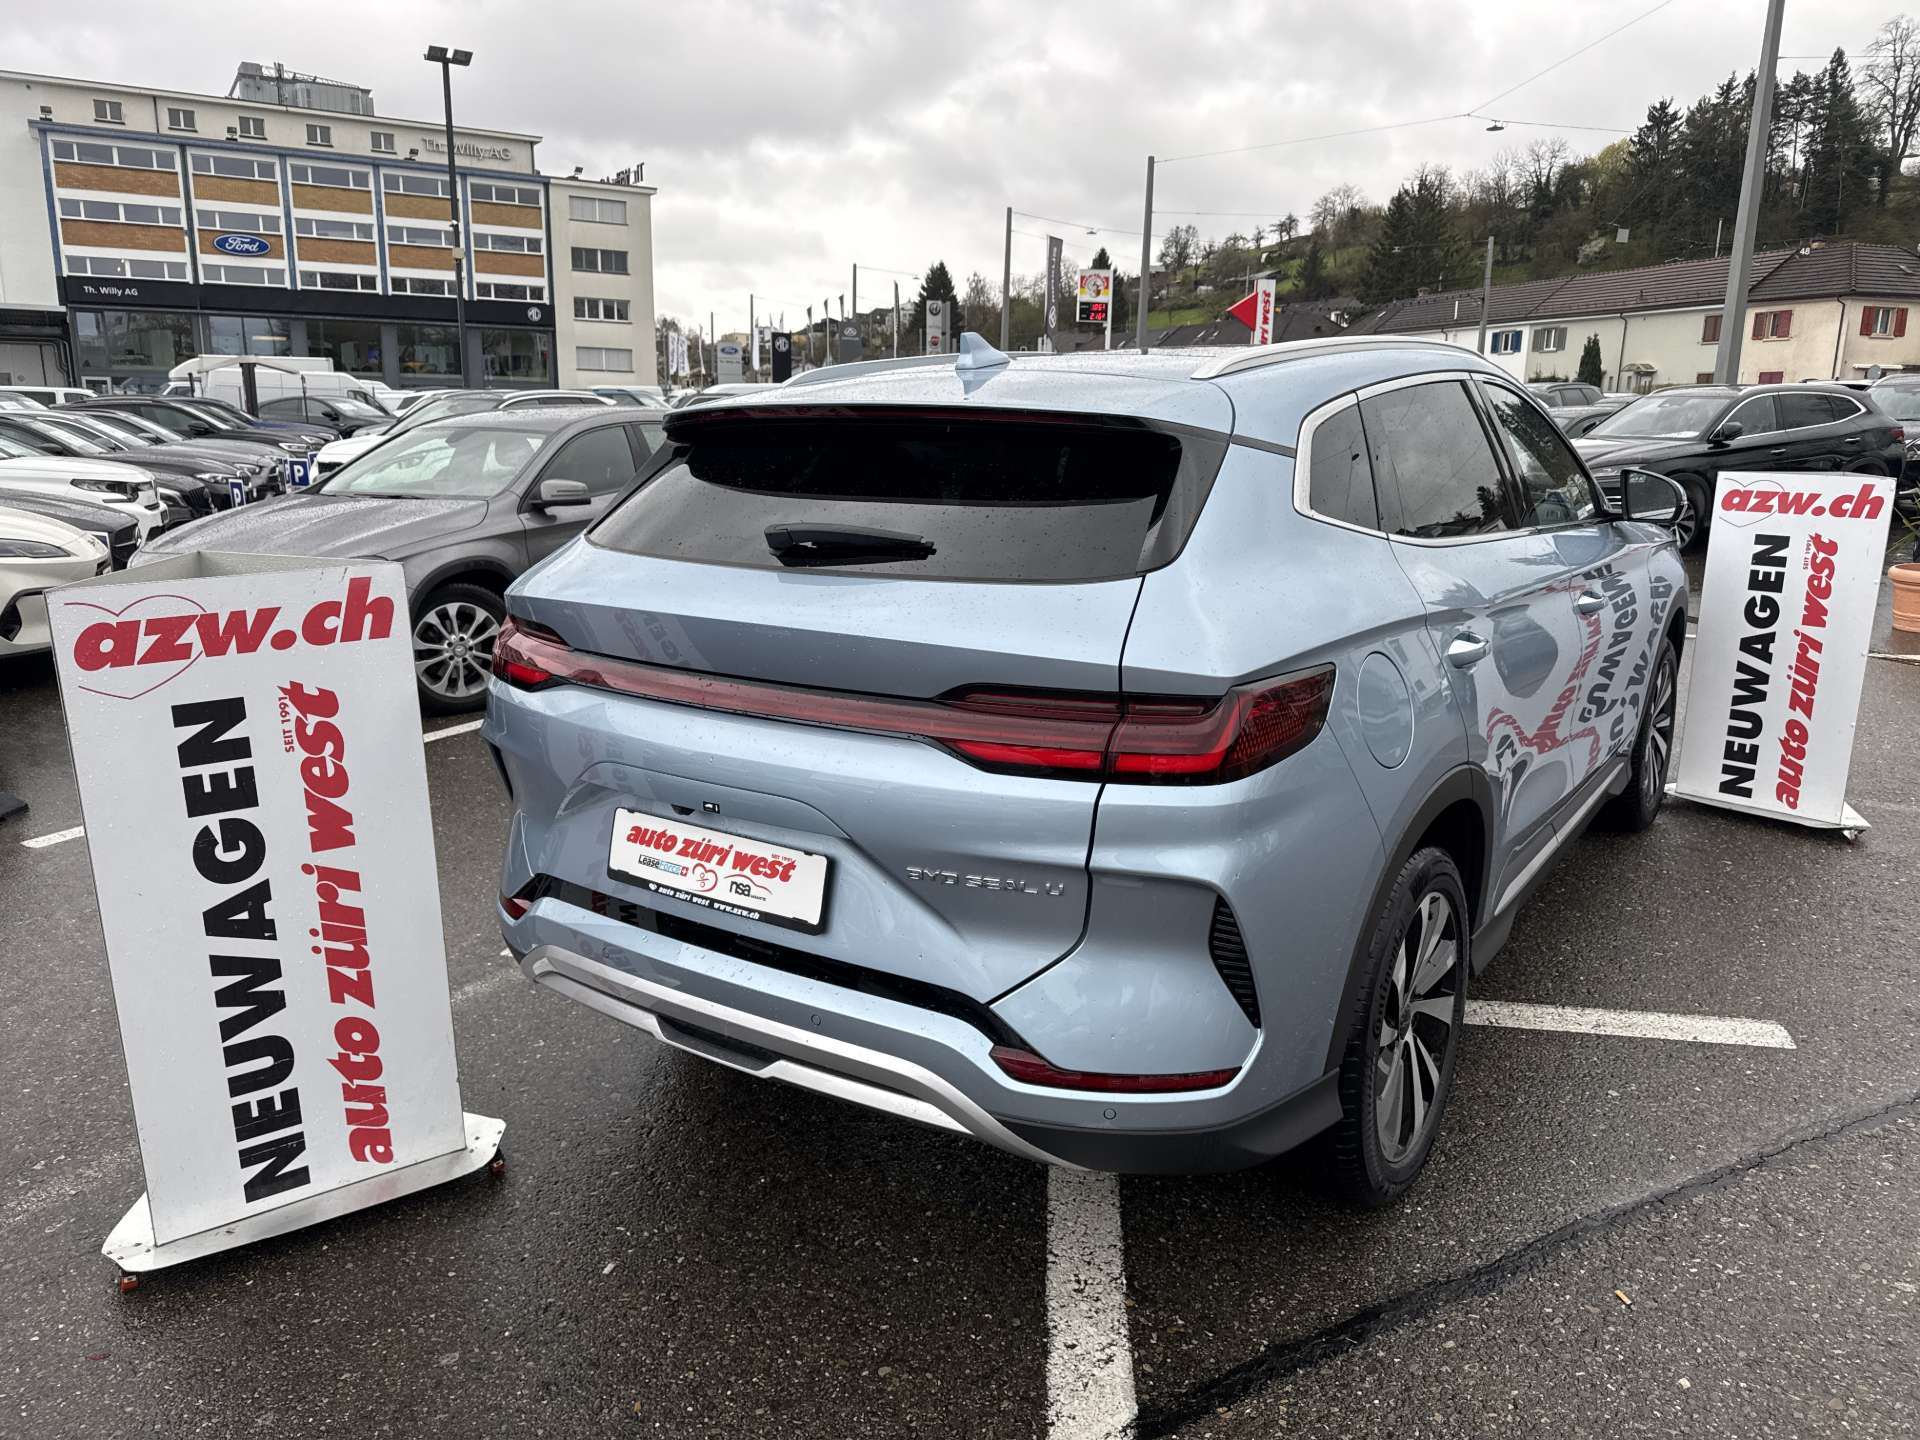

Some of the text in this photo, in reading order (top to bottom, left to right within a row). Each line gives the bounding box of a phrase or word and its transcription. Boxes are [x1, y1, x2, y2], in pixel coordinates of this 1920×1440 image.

[489, 144, 512, 161] AG
[225, 236, 260, 251] Ford
[83, 286, 138, 297] Th. Willy AG
[1262, 289, 1272, 325] west
[774, 336, 789, 352] MG
[293, 464, 304, 483] P
[232, 487, 242, 507] P
[1721, 483, 1885, 520] azw.ch
[73, 576, 394, 672] azw.ch
[1718, 533, 1791, 799] NEUWAGEN
[1775, 531, 1838, 810] auto züri west
[278, 696, 295, 753] SEIT 1991
[625, 825, 797, 883] auto züri west
[658, 886, 675, 896] auto
[692, 896, 710, 907] west
[729, 880, 751, 897] nsa
[906, 866, 1065, 896] BYD SEAL U
[277, 681, 394, 1165] auto züri west
[171, 696, 311, 1204] NEUWAGEN
